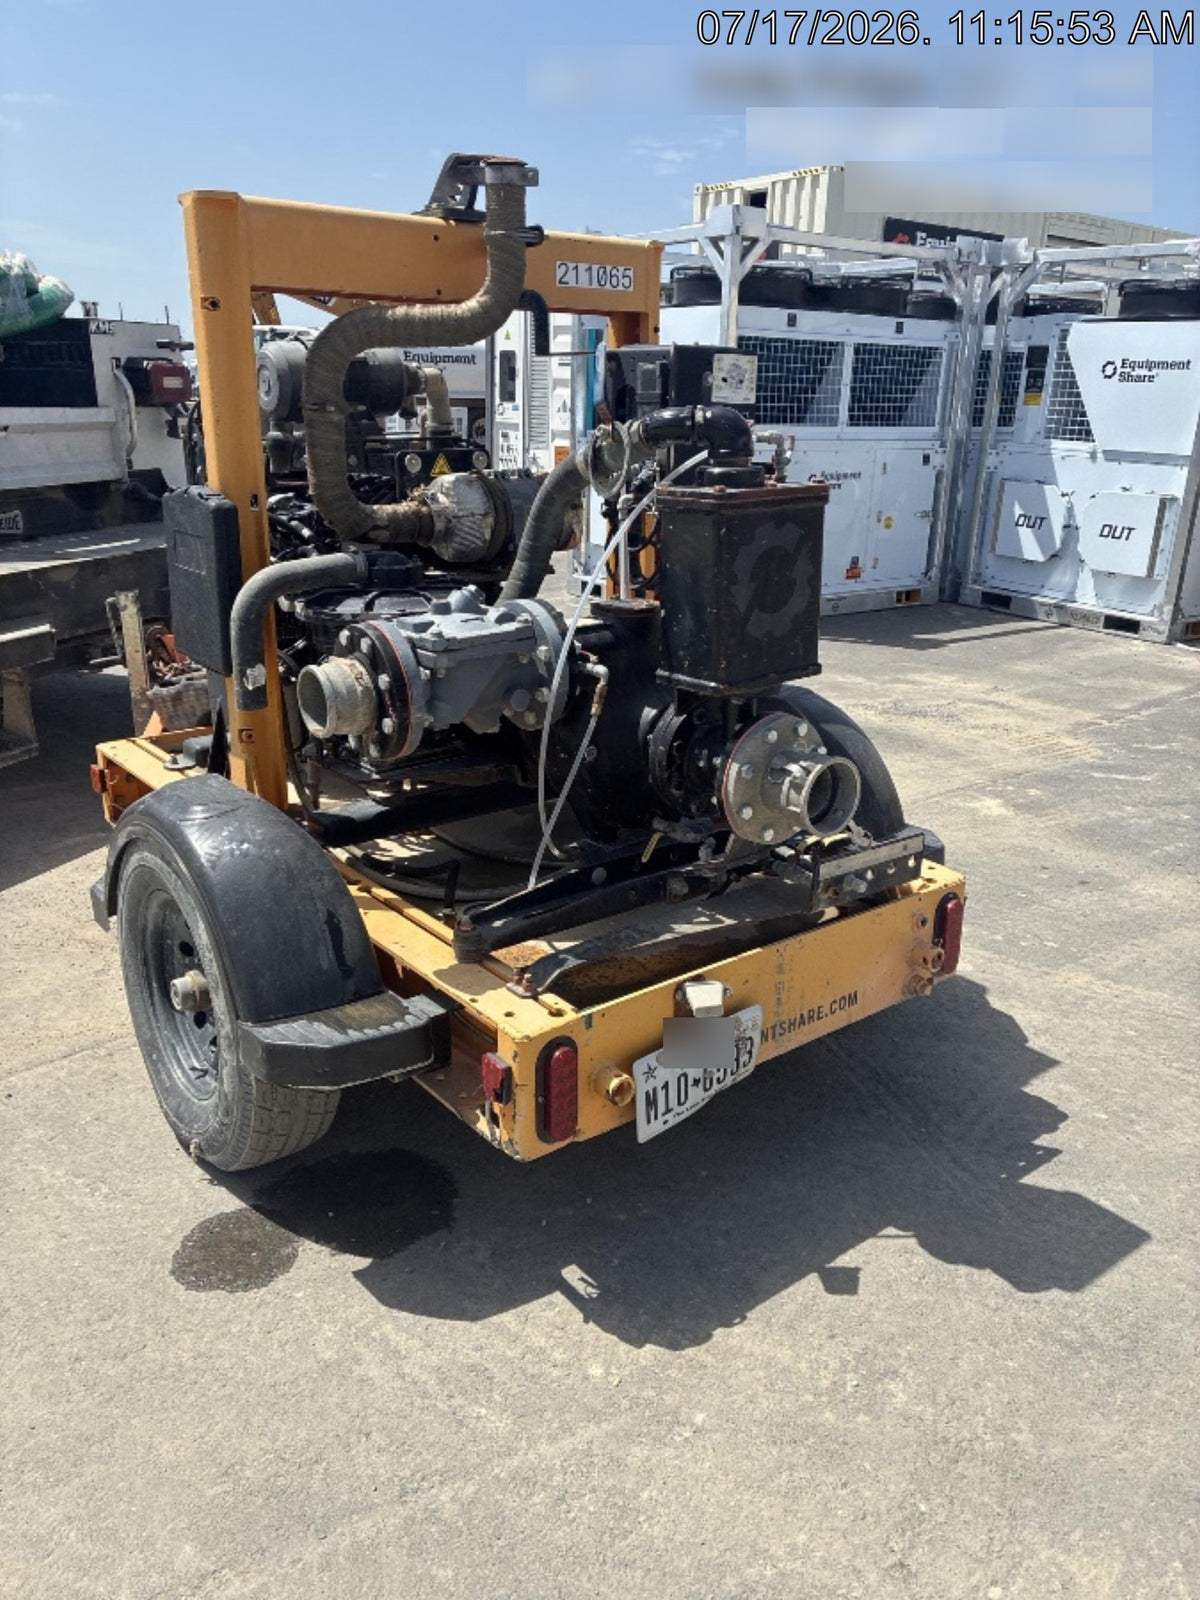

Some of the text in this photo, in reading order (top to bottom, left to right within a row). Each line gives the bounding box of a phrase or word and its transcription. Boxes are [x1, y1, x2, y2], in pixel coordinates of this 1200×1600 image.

[557, 262, 632, 289] 211065
[403, 350, 477, 365] Equipment
[1119, 358, 1192, 372] Equipment
[1014, 513, 1047, 530] OUT
[1098, 523, 1136, 541] OUT
[760, 990, 859, 1046] NTSHARE.COM
